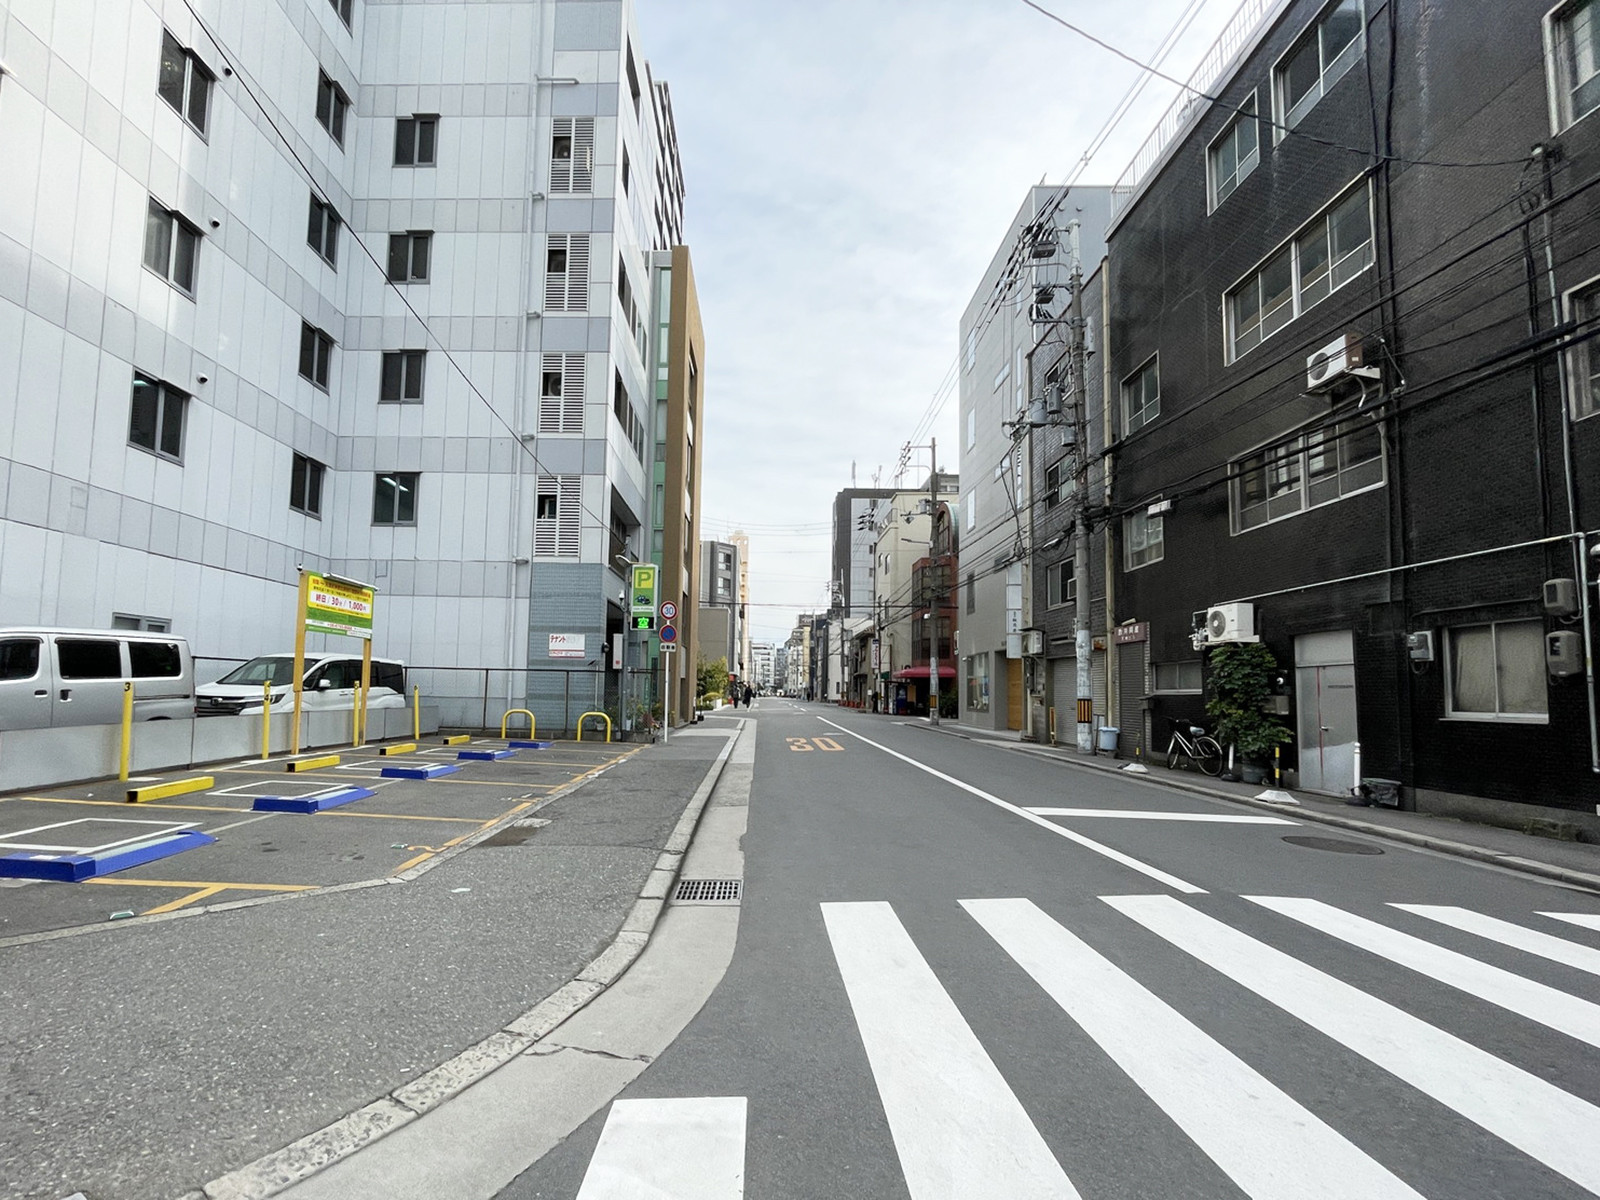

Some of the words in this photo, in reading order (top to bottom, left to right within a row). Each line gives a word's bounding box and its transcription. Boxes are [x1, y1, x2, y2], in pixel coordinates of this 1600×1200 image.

[639, 571, 651, 587] P
[664, 606, 674, 615] 30
[550, 634, 566, 643] テナント
[124, 681, 131, 692] 3
[785, 737, 845, 751] 30
